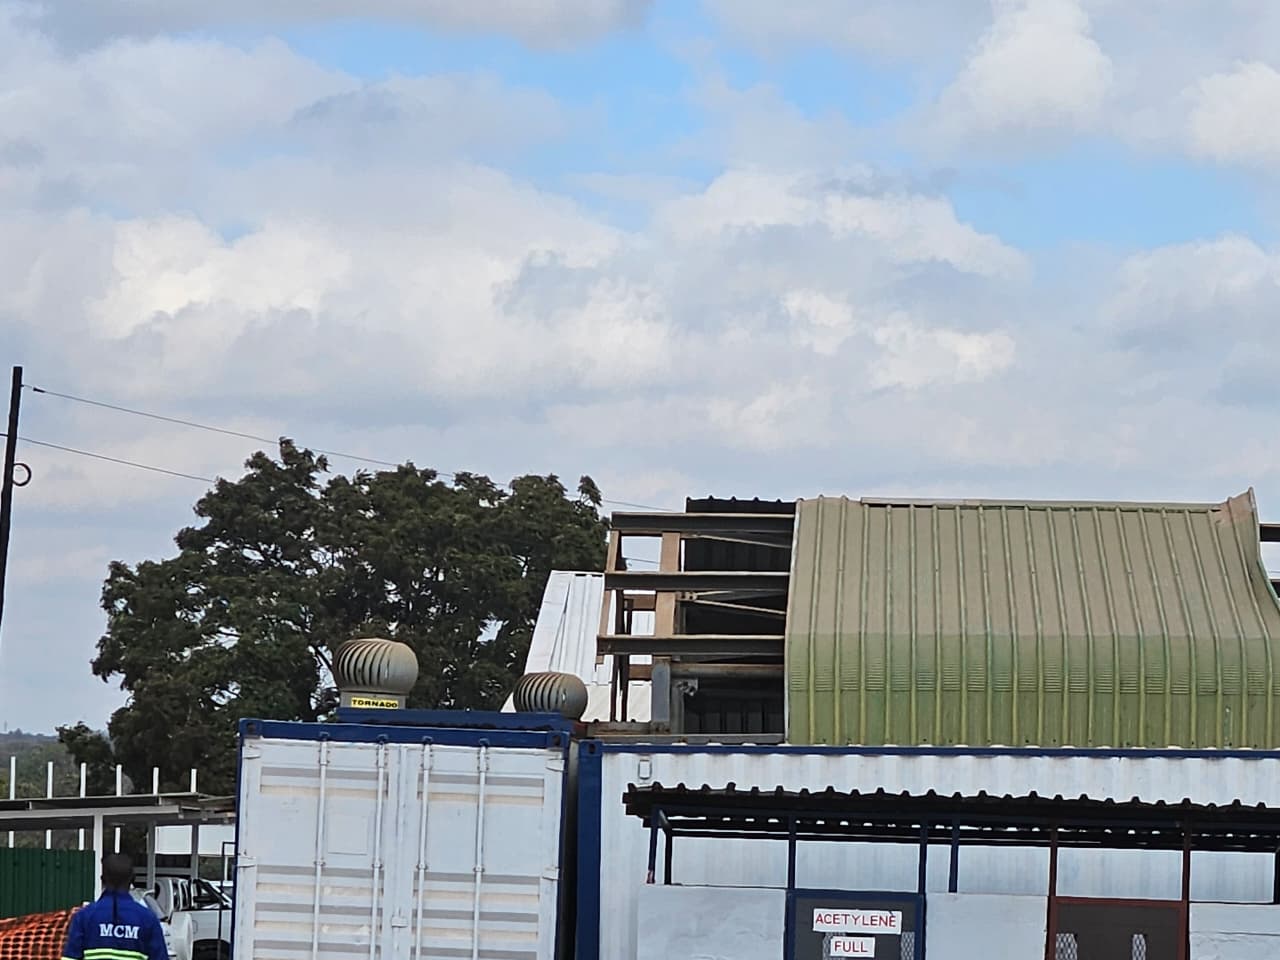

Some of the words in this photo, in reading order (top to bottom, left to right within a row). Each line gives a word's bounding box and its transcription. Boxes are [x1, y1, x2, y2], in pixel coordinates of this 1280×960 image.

[352, 699, 398, 708] TORNADO
[815, 913, 897, 927] ACETYLENE
[99, 923, 140, 939] MCM
[834, 941, 868, 953] FULL
